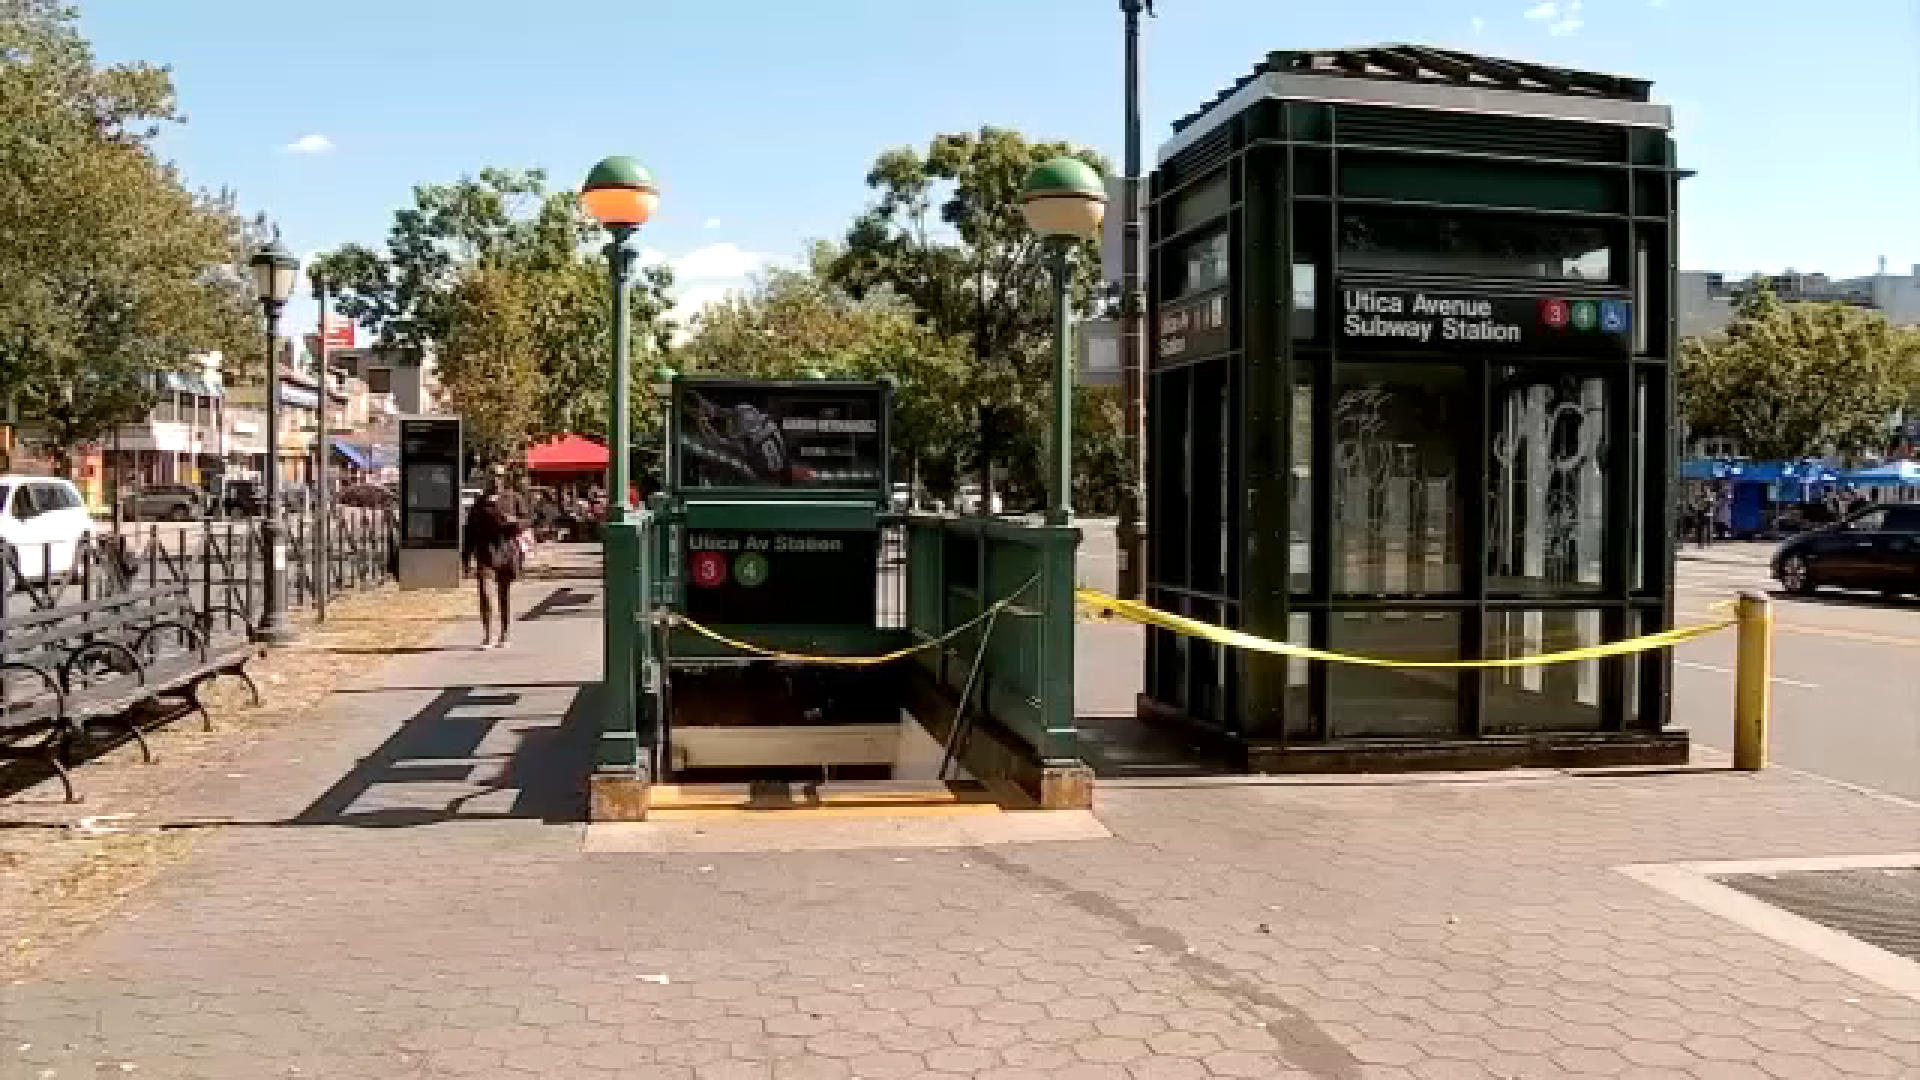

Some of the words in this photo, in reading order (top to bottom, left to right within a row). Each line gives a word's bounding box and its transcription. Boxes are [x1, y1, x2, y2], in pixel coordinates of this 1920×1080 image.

[1345, 290, 1402, 313] Utica
[1412, 294, 1492, 316] Avenue
[1549, 304, 1562, 323] 3
[1578, 304, 1591, 323] 4
[1344, 315, 1432, 342] Subway
[1442, 318, 1521, 342] Station
[689, 535, 739, 550] Utica
[744, 536, 769, 551] Av
[774, 536, 842, 551] Station
[701, 561, 716, 580] 3
[743, 562, 757, 580] 4
